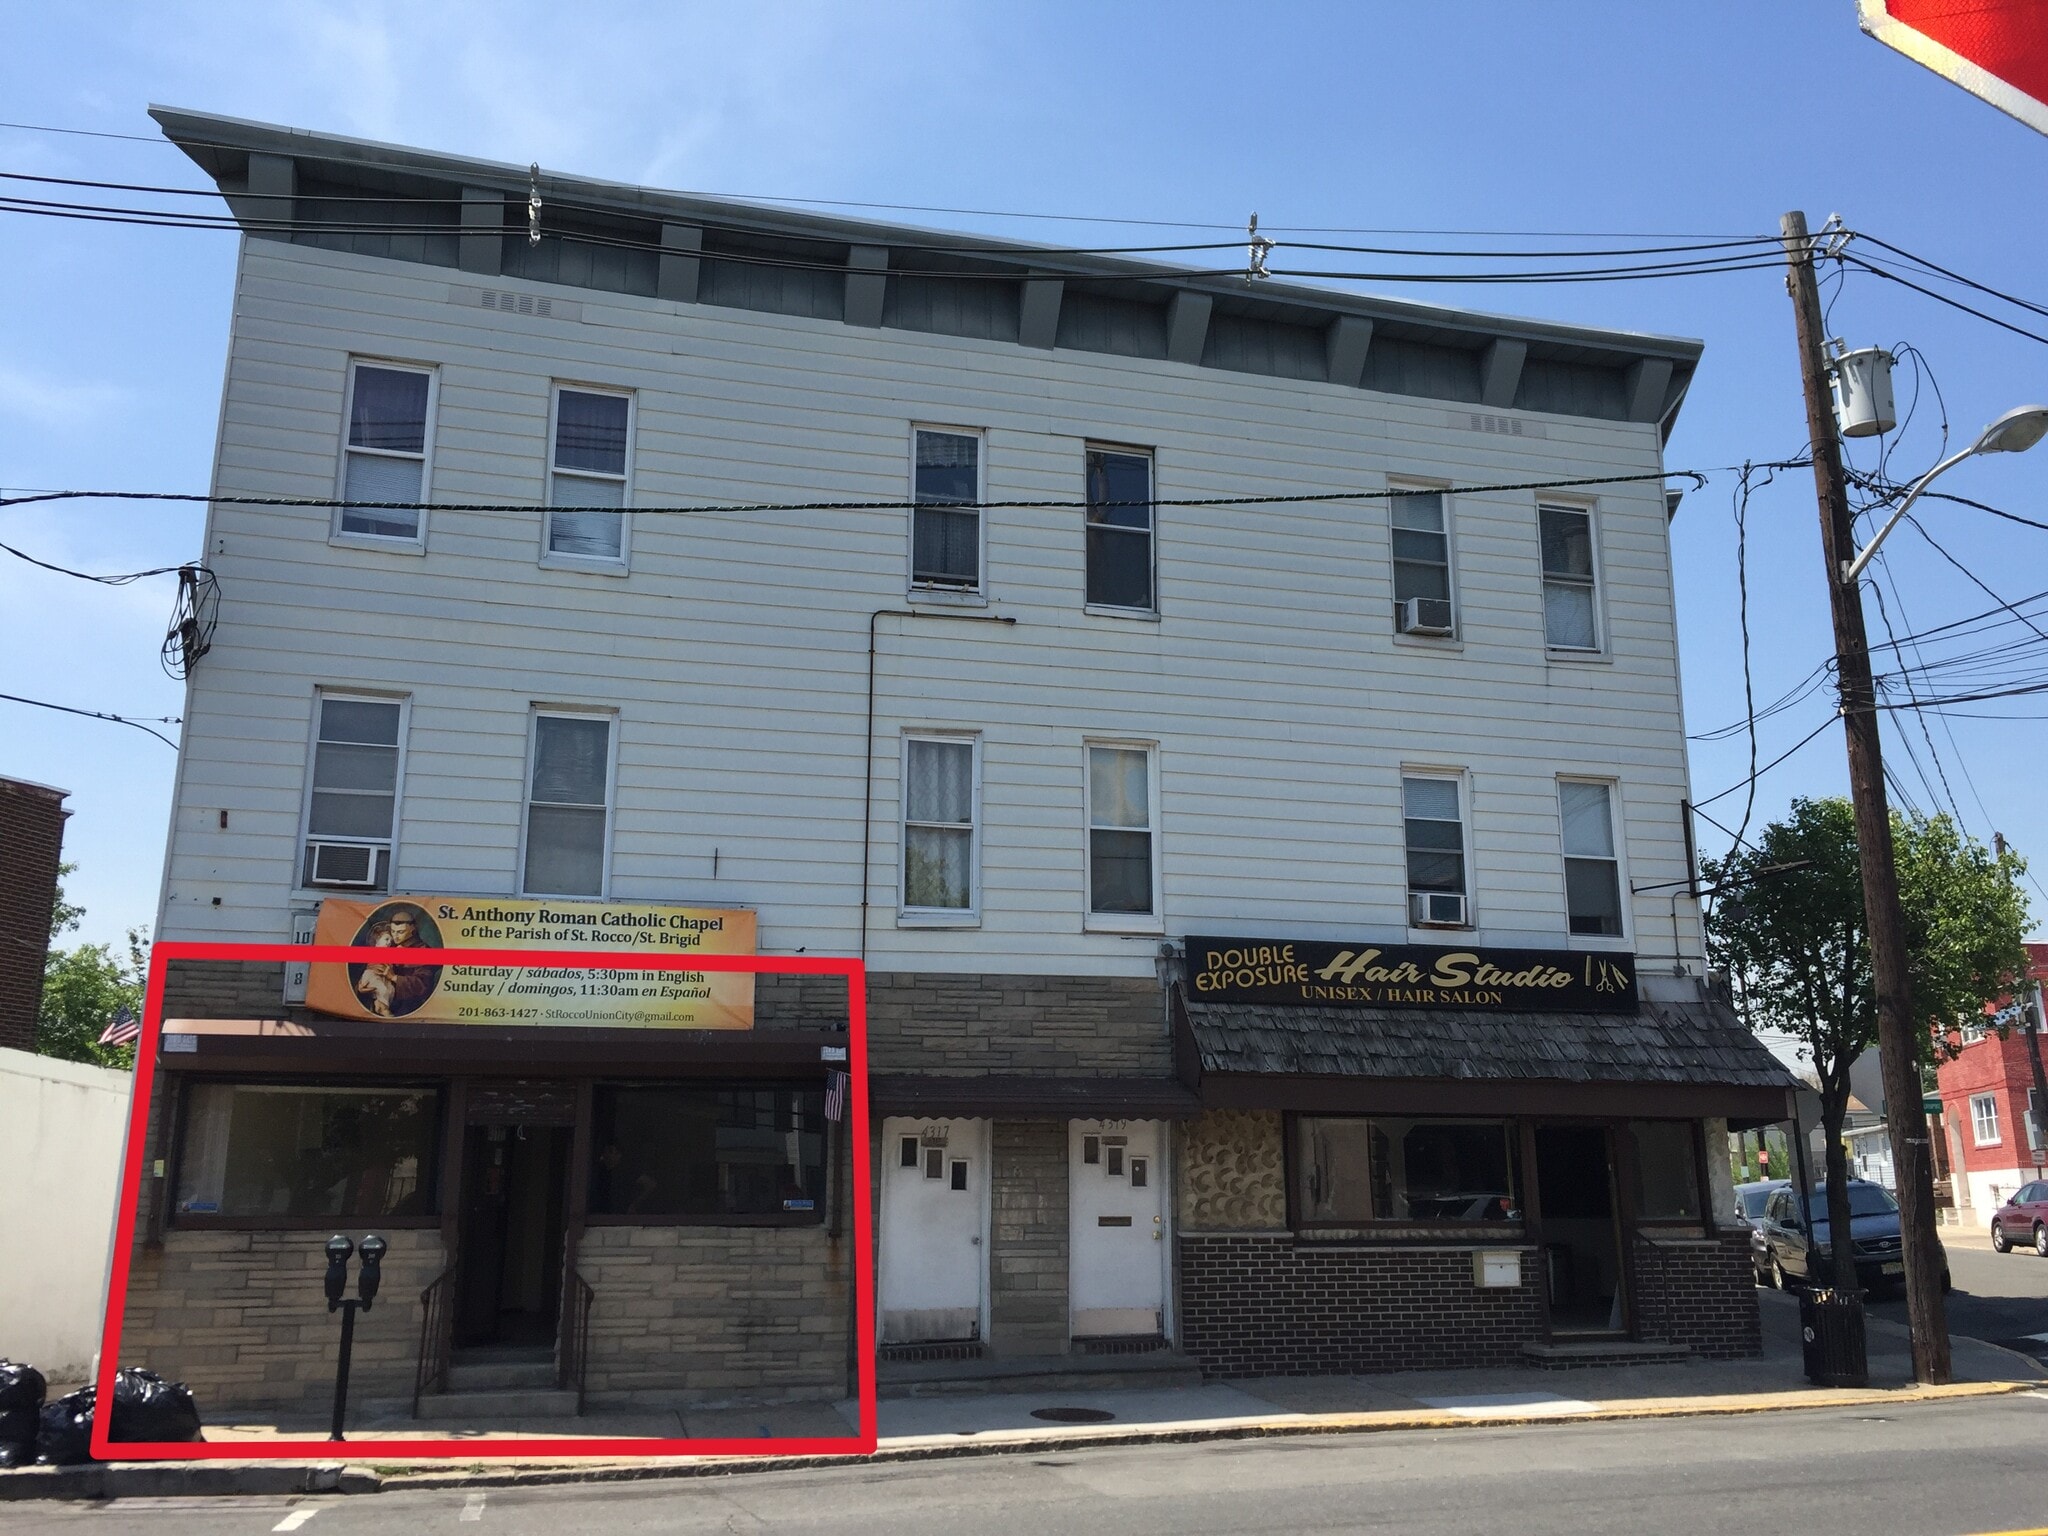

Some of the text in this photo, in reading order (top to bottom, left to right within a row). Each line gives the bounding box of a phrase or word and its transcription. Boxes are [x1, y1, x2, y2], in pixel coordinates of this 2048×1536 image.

[438, 905, 723, 933] St. Anthony Roman Catholic Chapel
[461, 925, 477, 938] of
[479, 926, 502, 938] the
[506, 927, 551, 940] Parish
[554, 928, 570, 941] of
[571, 929, 588, 942] St.
[659, 932, 701, 948] Brigid
[1206, 944, 1295, 970] DOUBLE
[451, 965, 513, 980] Saturday
[526, 967, 584, 981] sábados,
[587, 968, 638, 983] 5:30pm
[641, 969, 654, 981] in
[658, 970, 705, 985] English
[1195, 963, 1310, 992] EXPOSURE
[1313, 948, 1575, 988] Hair Studio
[443, 980, 495, 996] Sunday
[508, 982, 577, 997] domingos,
[580, 984, 639, 997] 11:30am
[641, 987, 657, 997] en
[660, 985, 712, 1000] Español
[1301, 985, 1372, 1001] UNISEX
[1387, 988, 1436, 1004] HAIR
[1440, 989, 1502, 1004] SALON
[458, 1007, 695, 1022] 201-863-1427 StRoccoUnionCity@gmail.com
[921, 1125, 950, 1138] 4317
